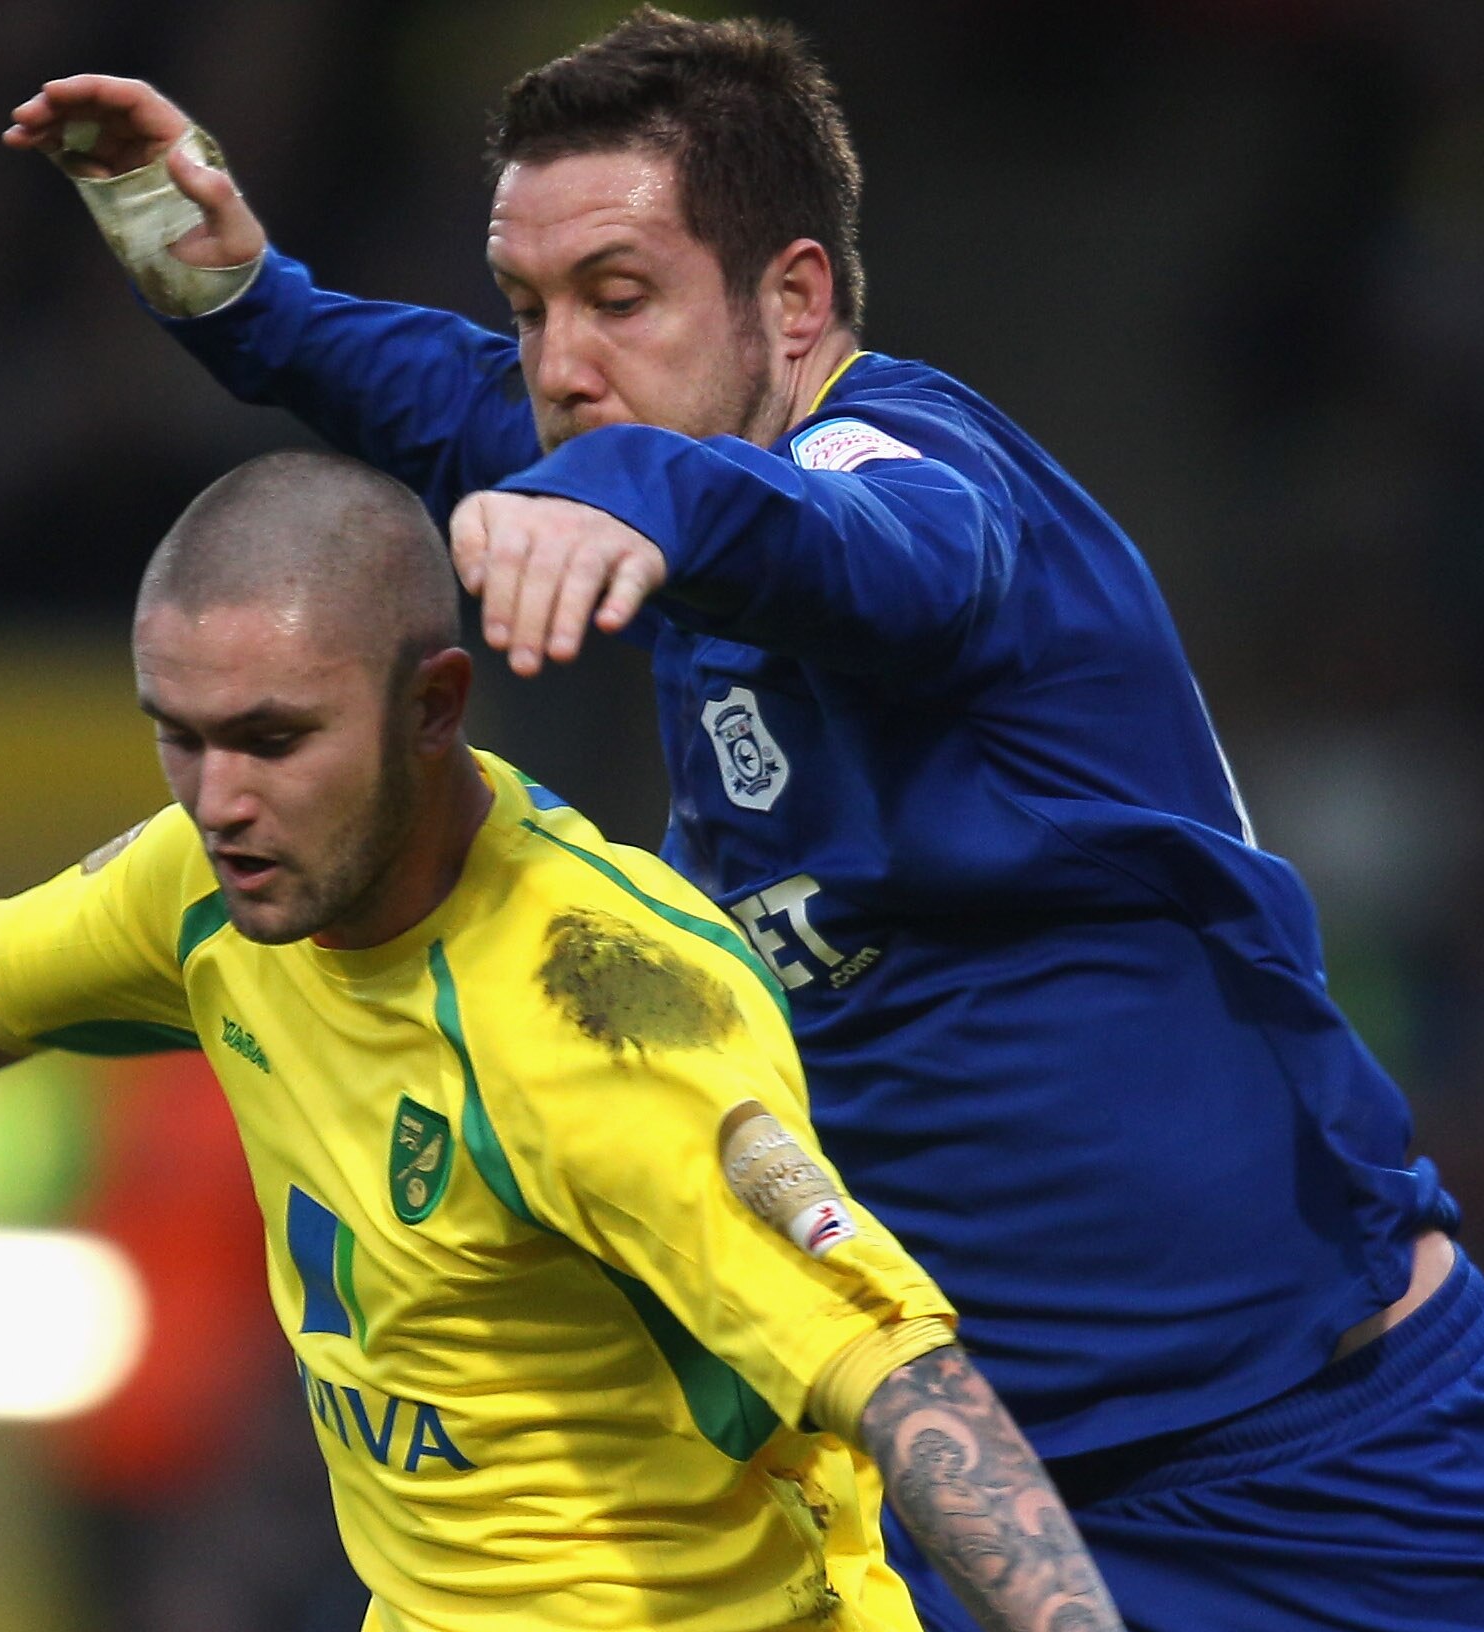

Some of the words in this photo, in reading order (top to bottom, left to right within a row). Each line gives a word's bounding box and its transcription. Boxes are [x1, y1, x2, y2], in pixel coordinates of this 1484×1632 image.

[727, 873, 845, 991] ET
[829, 947, 882, 989] .com
[297, 1356, 478, 1472] IVA
